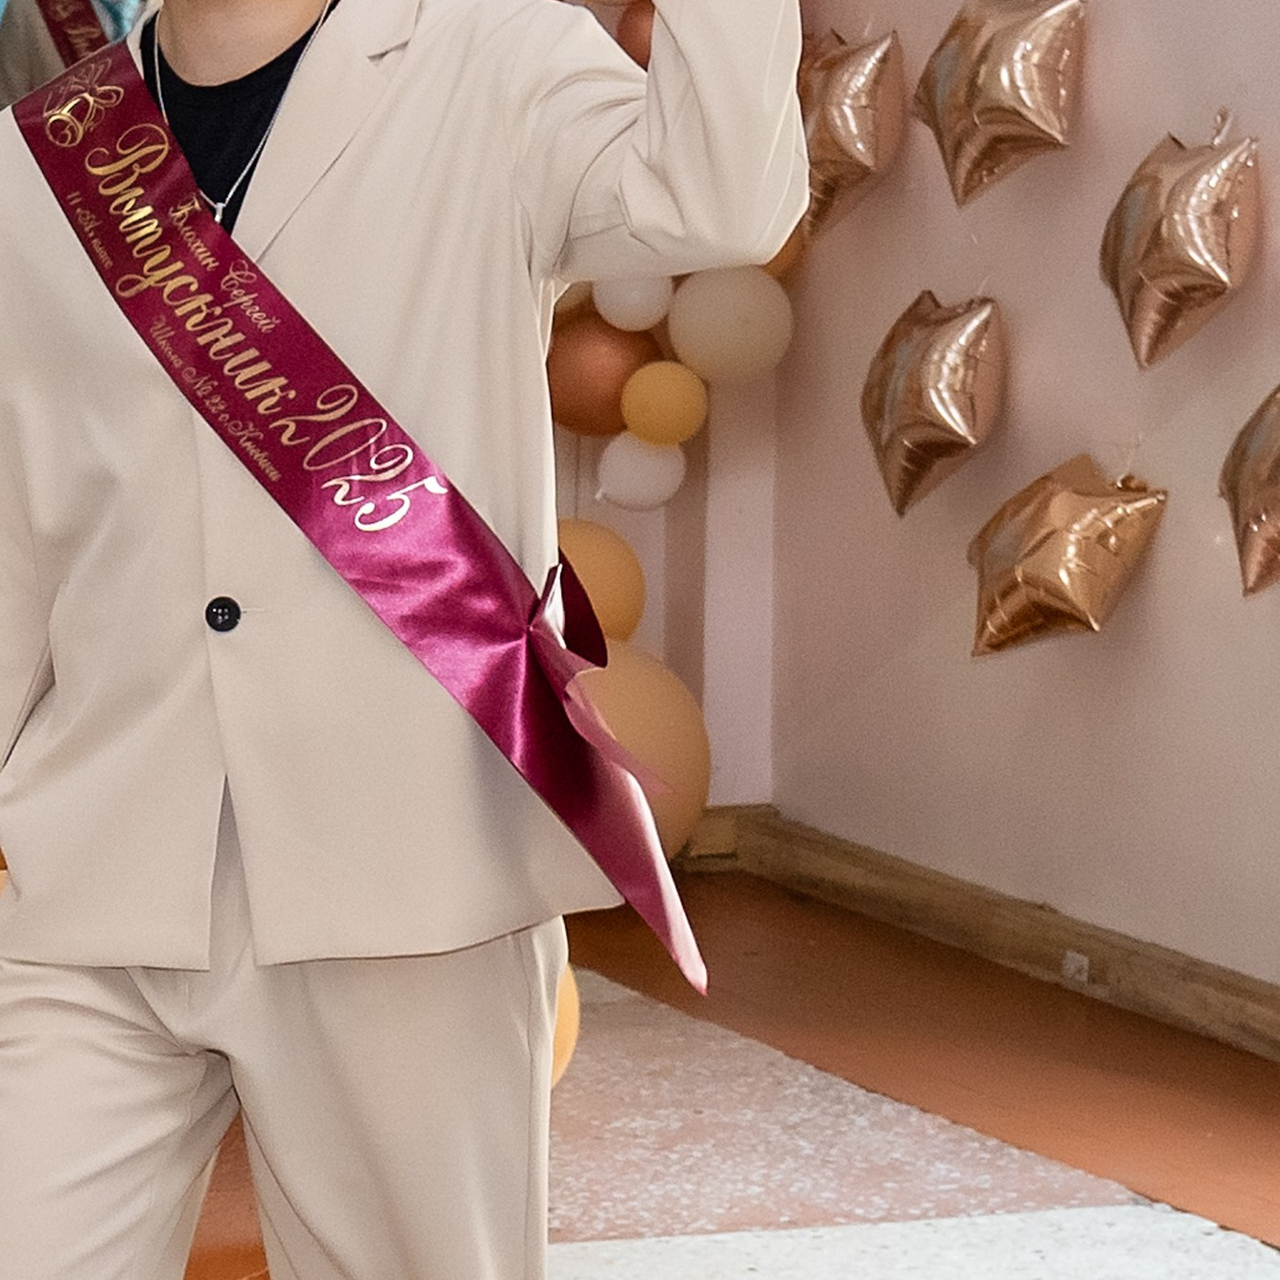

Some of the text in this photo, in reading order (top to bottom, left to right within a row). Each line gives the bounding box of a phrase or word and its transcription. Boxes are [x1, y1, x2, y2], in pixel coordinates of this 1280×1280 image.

[85, 123, 447, 532] Выпускник 2025
[167, 195, 279, 333] Блохин Сергей
[150, 314, 183, 368] Школа
[203, 391, 227, 414] 22
